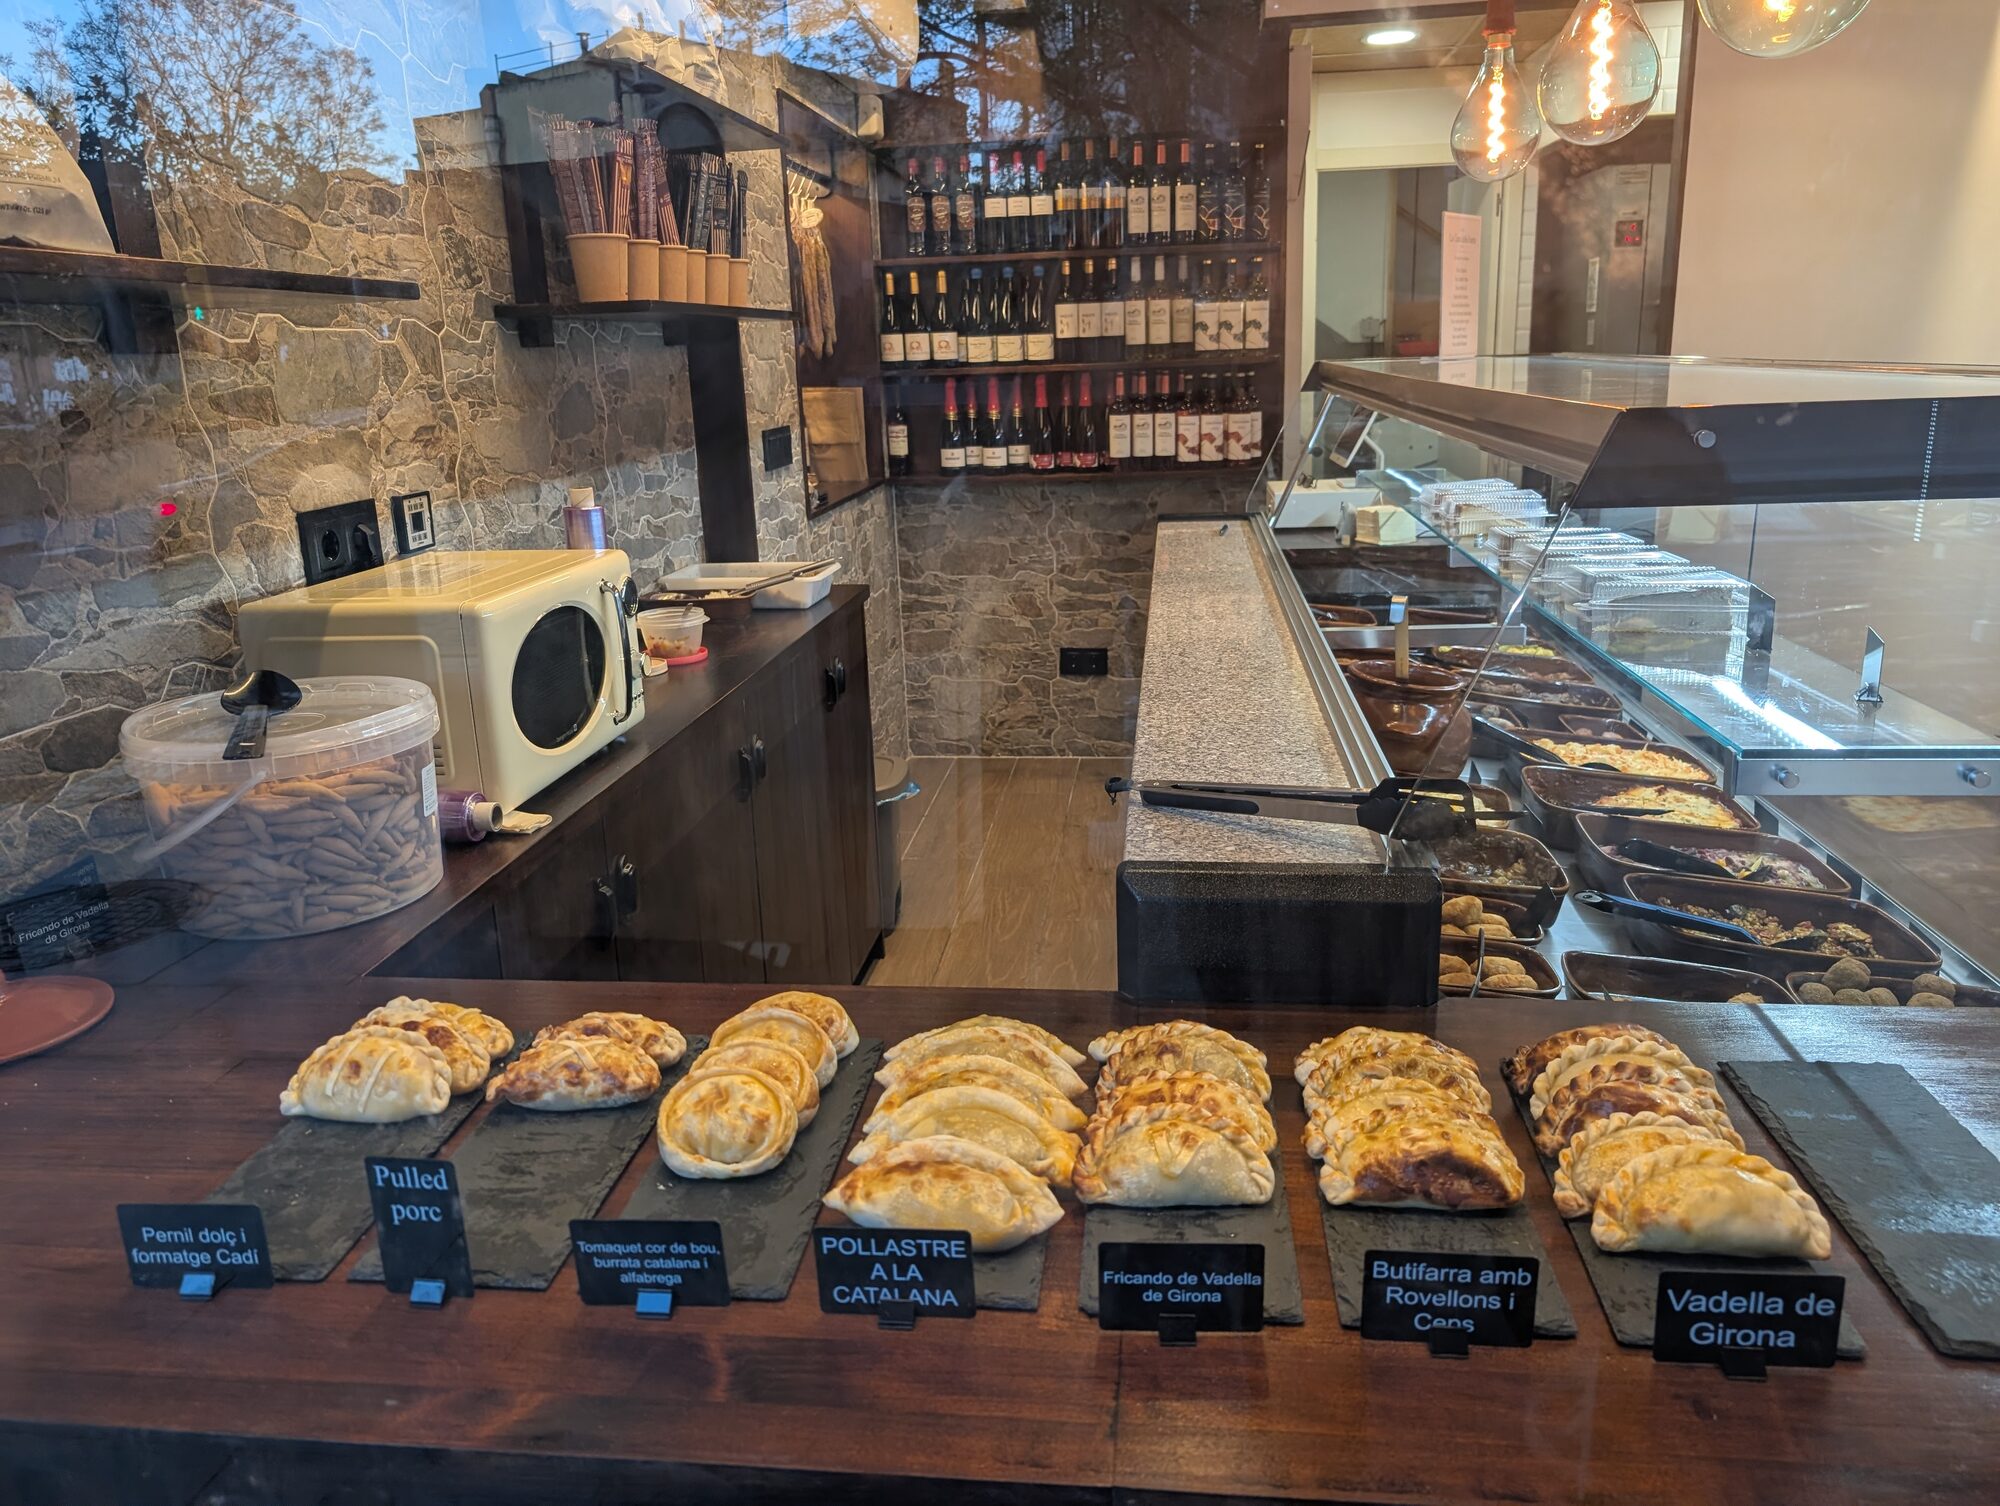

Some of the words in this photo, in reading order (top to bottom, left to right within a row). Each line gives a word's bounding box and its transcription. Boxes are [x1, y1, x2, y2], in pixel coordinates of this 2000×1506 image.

[18, 921, 61, 943] Fricando
[62, 915, 75, 926] de
[45, 934, 57, 945] de
[59, 921, 91, 938] Girona
[372, 1164, 449, 1191] Pulled
[390, 1203, 443, 1226] porc
[141, 1226, 194, 1244] Pernil
[198, 1227, 238, 1247] dolç
[240, 1228, 247, 1244] i
[644, 1243, 667, 1254] cor
[669, 1242, 688, 1254] de
[821, 1236, 968, 1259] POLLASTRE
[131, 1248, 212, 1268] formatge
[593, 1256, 641, 1269] burrata
[643, 1257, 701, 1269] catalana
[703, 1258, 709, 1269] i
[870, 1262, 888, 1281] A
[892, 1263, 924, 1282] LA
[1103, 1270, 1174, 1285] Fricando
[1177, 1271, 1198, 1286] de
[1202, 1272, 1262, 1286] Vadella
[1371, 1260, 1472, 1283] Butifarra
[1479, 1267, 1533, 1286] amb
[1142, 1288, 1163, 1302] de
[1167, 1288, 1222, 1303] Girona
[1385, 1286, 1502, 1310] Rovellons
[1508, 1292, 1516, 1311] i
[1666, 1288, 1784, 1315] Vadella
[1794, 1292, 1837, 1317] de
[1688, 1321, 1796, 1348] Girona
